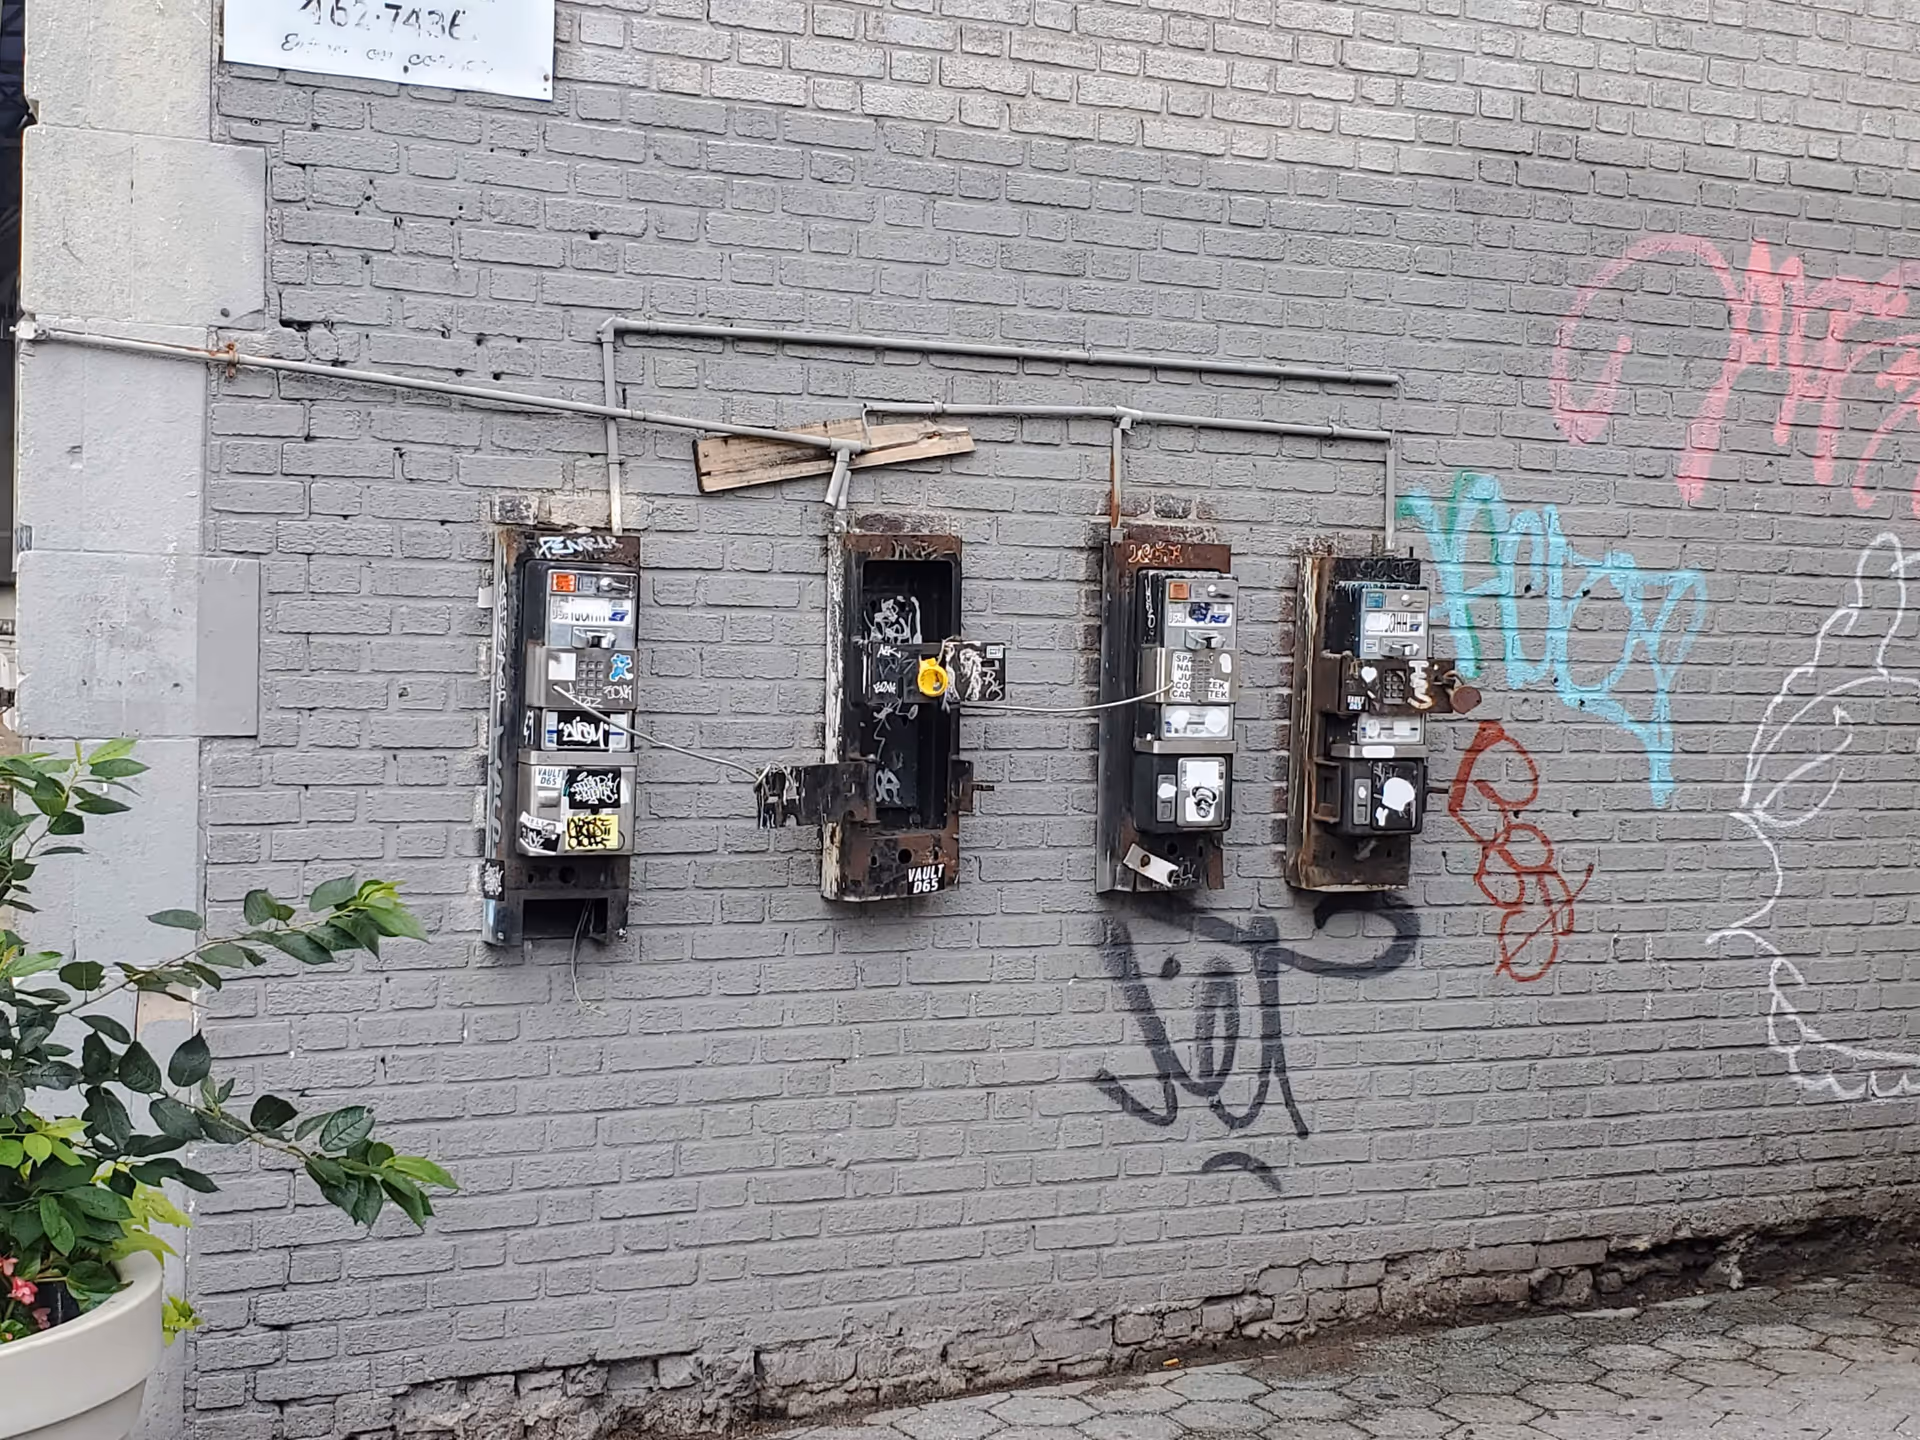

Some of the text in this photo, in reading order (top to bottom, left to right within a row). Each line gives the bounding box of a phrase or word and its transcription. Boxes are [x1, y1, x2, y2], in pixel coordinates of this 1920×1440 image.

[538, 767, 561, 778] VAULT
[908, 863, 945, 883] VAULT
[913, 878, 939, 894] D65
